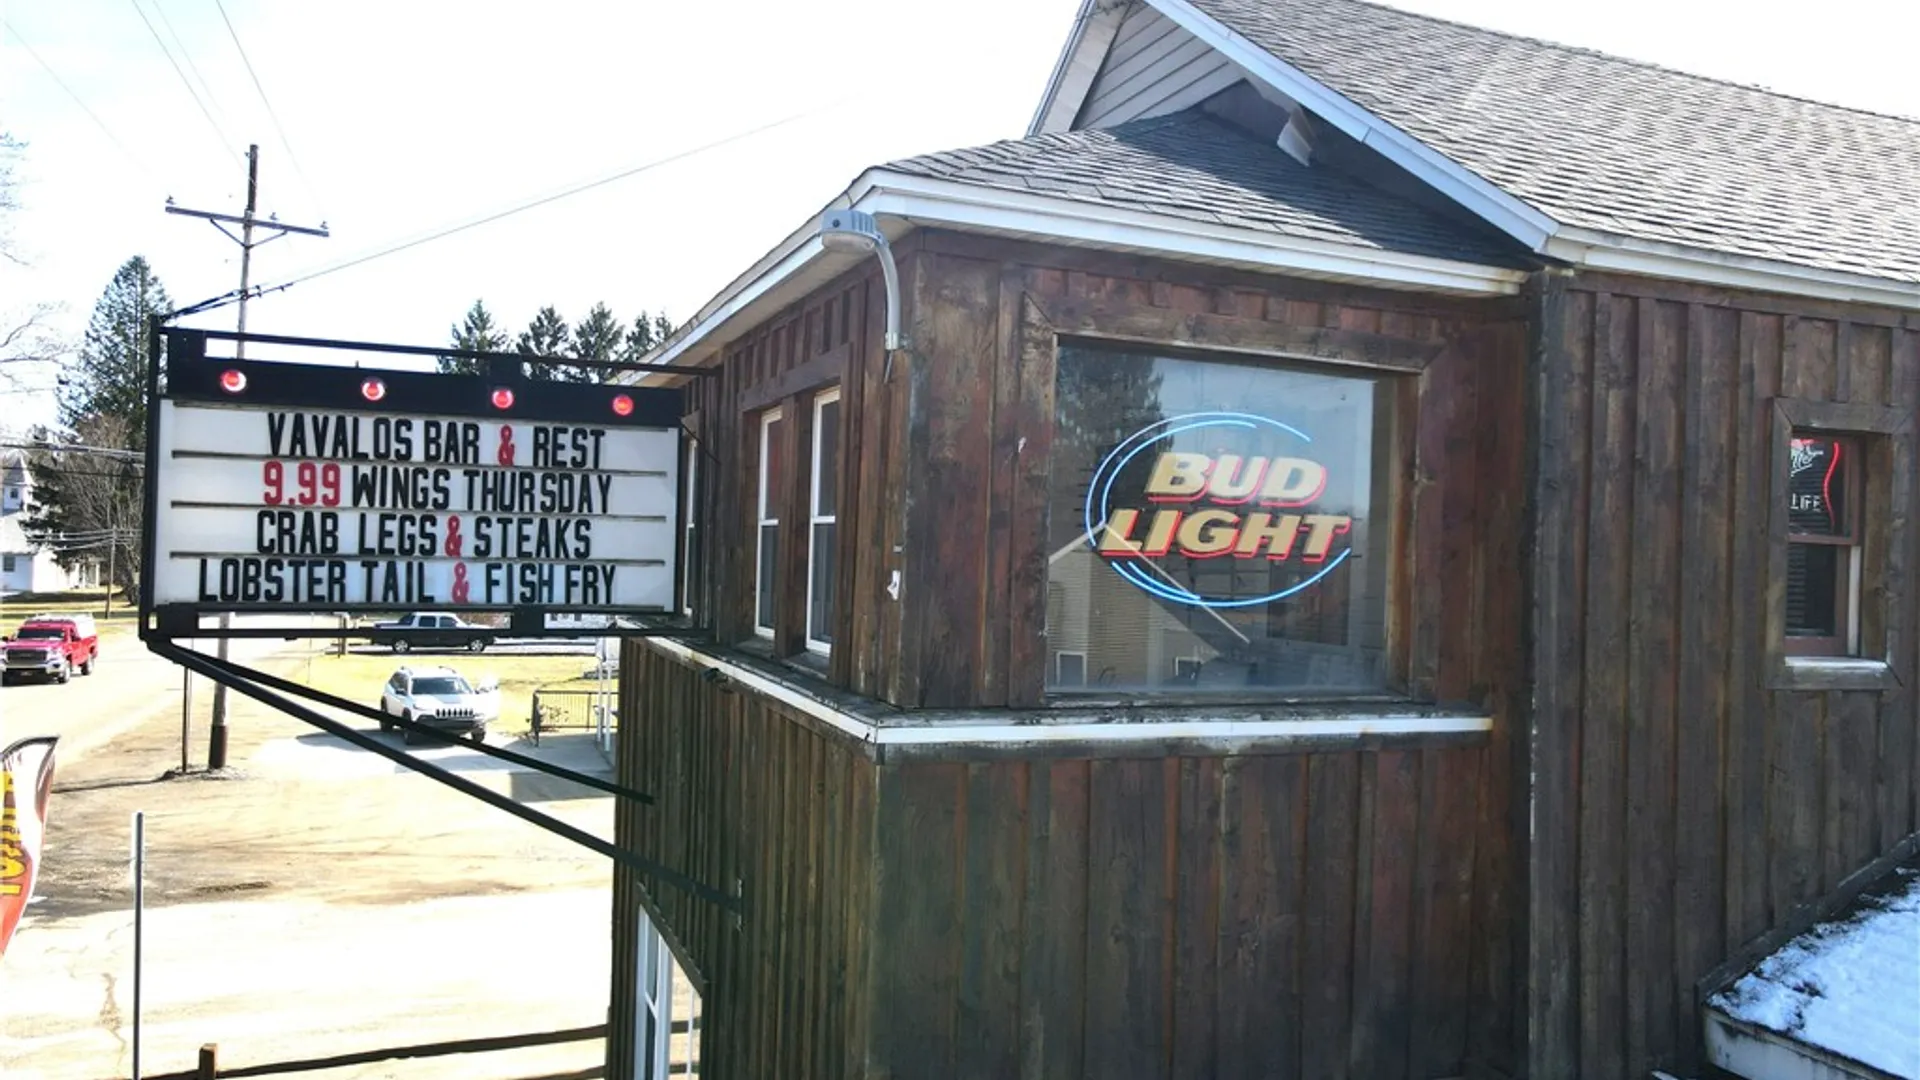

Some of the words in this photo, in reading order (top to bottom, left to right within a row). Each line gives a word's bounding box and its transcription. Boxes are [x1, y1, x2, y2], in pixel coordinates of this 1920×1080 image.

[267, 412, 413, 461] VAVALOS
[424, 420, 480, 465] BAR
[497, 424, 515, 467] &
[532, 426, 605, 469] REST
[263, 460, 341, 507] 9.99
[352, 465, 450, 510] WINGS
[463, 470, 612, 514] THURSDAY
[1145, 452, 1327, 507] BUD
[1790, 493, 1821, 513] LIFE
[257, 510, 339, 555] CRAB
[358, 513, 438, 557] LEGS
[444, 515, 463, 558] &
[473, 516, 591, 559] STEAKS
[1099, 508, 1352, 563] LIGHT
[200, 558, 346, 602] LOBSTER
[360, 560, 435, 604] TAIL
[451, 562, 470, 604] &
[485, 563, 554, 605] FISH
[565, 565, 616, 605] FRY
